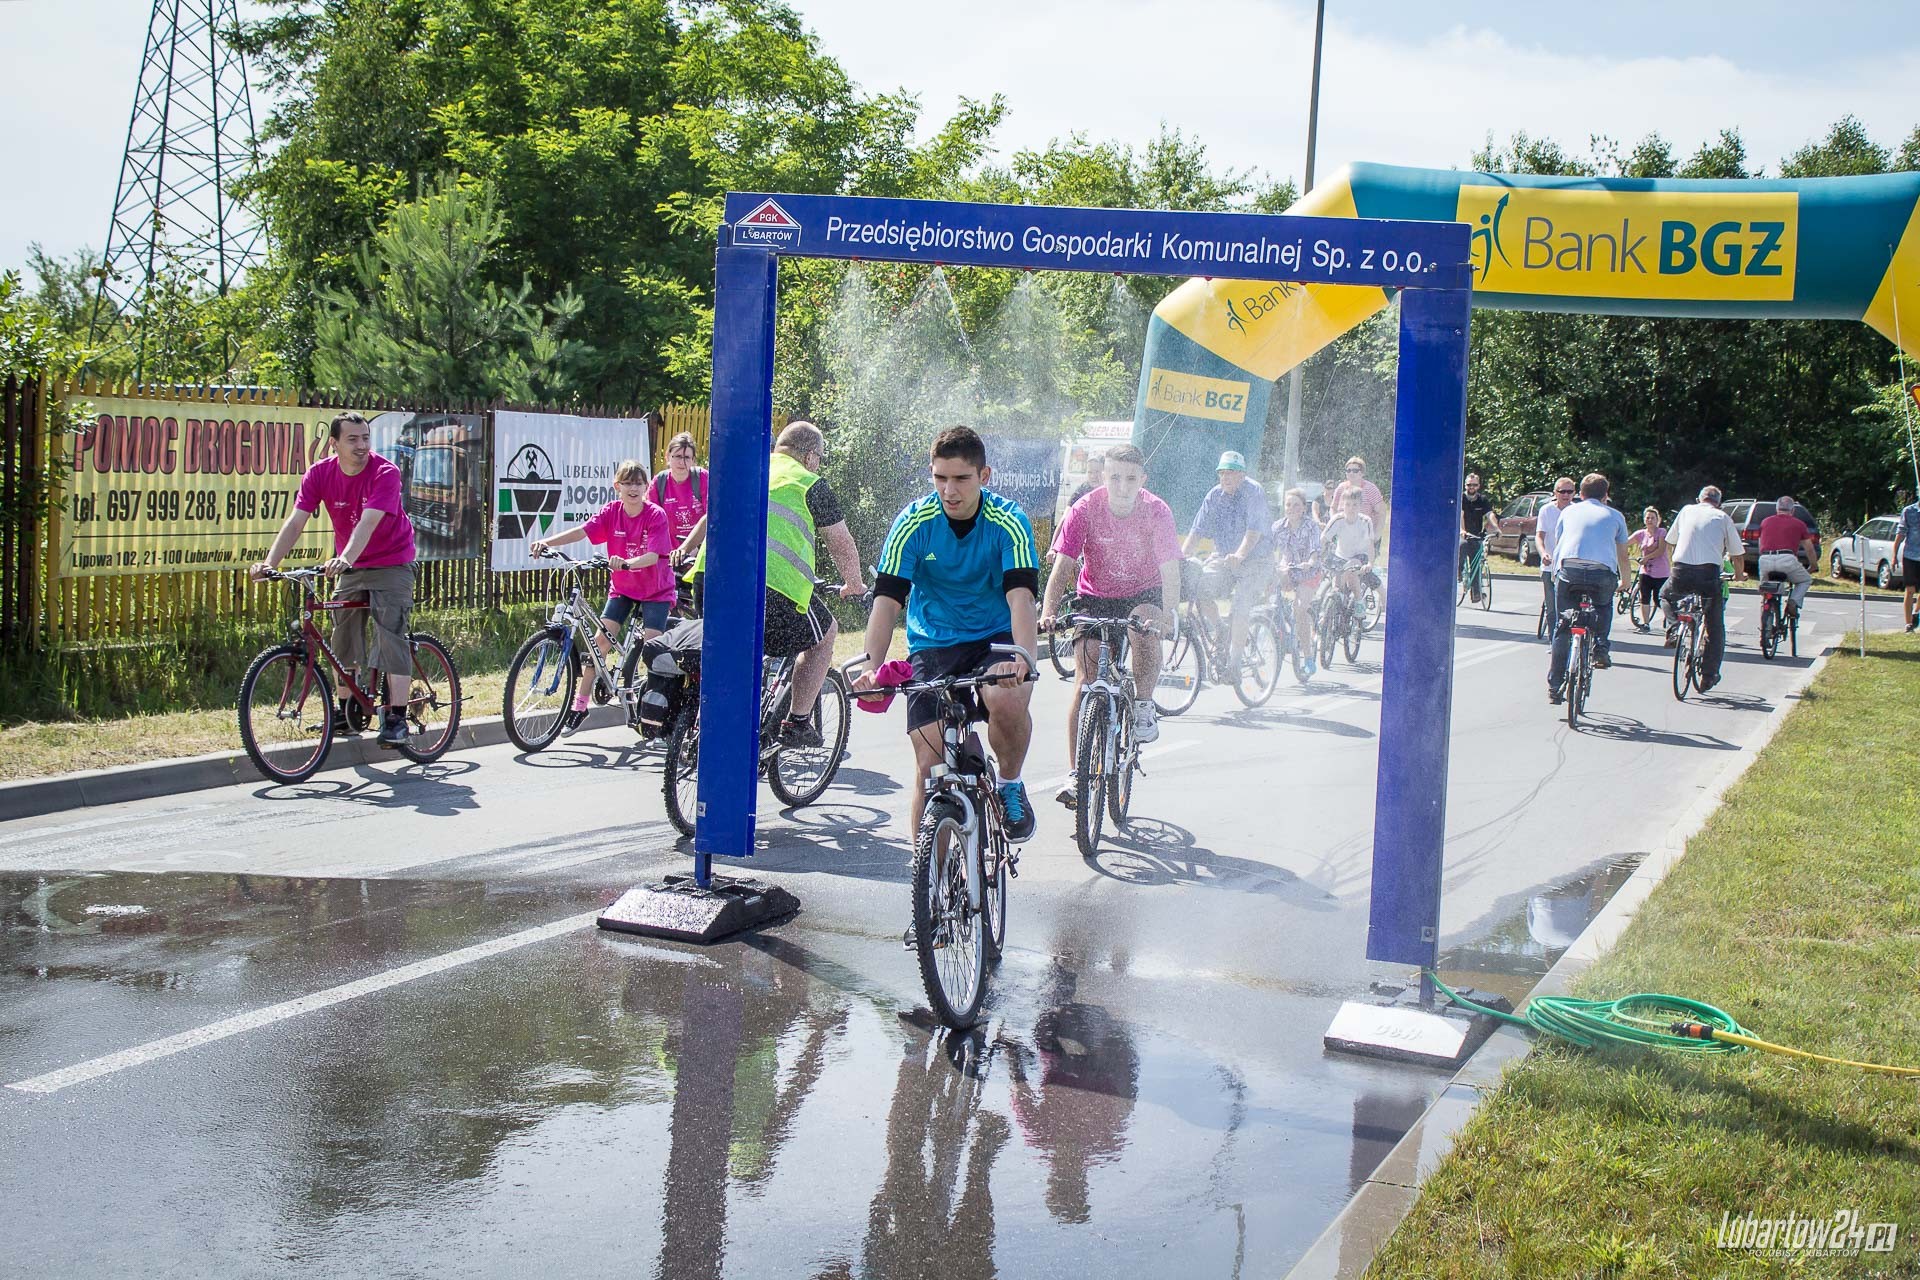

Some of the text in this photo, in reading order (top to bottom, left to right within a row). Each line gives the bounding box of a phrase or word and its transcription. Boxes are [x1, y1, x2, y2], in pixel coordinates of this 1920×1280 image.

[759, 213, 779, 223] PGK
[826, 215, 1428, 275] Przedsiębiorstwo Gospodarki Komunalnej Sp. z o.o.
[1522, 216, 1648, 274] Bank
[1242, 282, 1298, 321] Bank
[1163, 382, 1203, 406] Bank
[73, 414, 179, 475] POMOC
[184, 419, 306, 476] DROGOWA
[562, 461, 610, 479] LUBELSKI
[73, 492, 101, 522] tel.
[107, 489, 142, 522] 697
[147, 489, 180, 521] 999
[185, 489, 221, 525] 288,
[226, 489, 256, 520] 609
[260, 489, 290, 519] 377
[72, 552, 113, 569] Lipowa
[116, 551, 140, 568] 102,
[143, 550, 182, 566] 21-100
